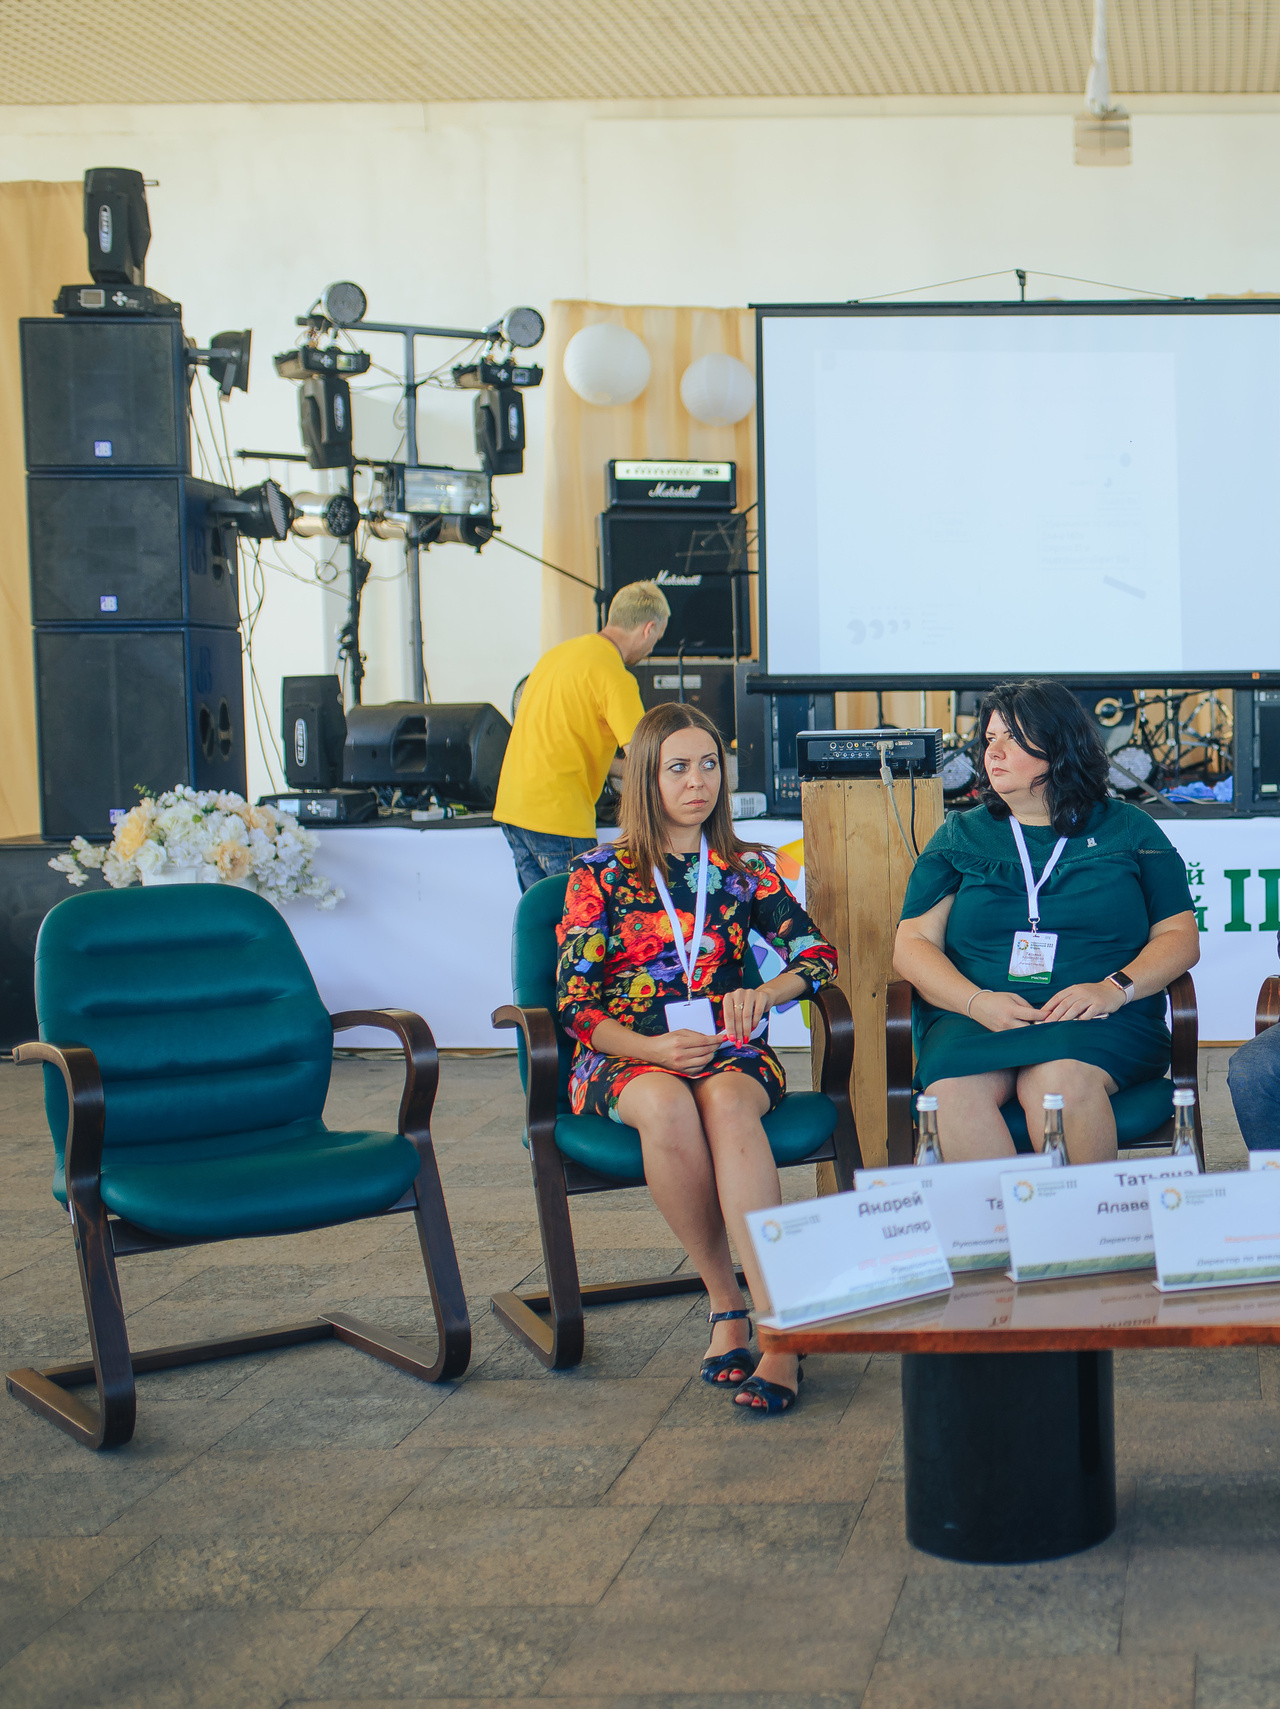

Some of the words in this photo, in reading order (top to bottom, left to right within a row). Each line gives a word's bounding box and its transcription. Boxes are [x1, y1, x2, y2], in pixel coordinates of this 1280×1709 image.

[648, 481, 702, 499] Marshall
[651, 569, 703, 586] Marshall
[858, 1191, 924, 1218] Андрей
[881, 1219, 933, 1240] Шкляр
